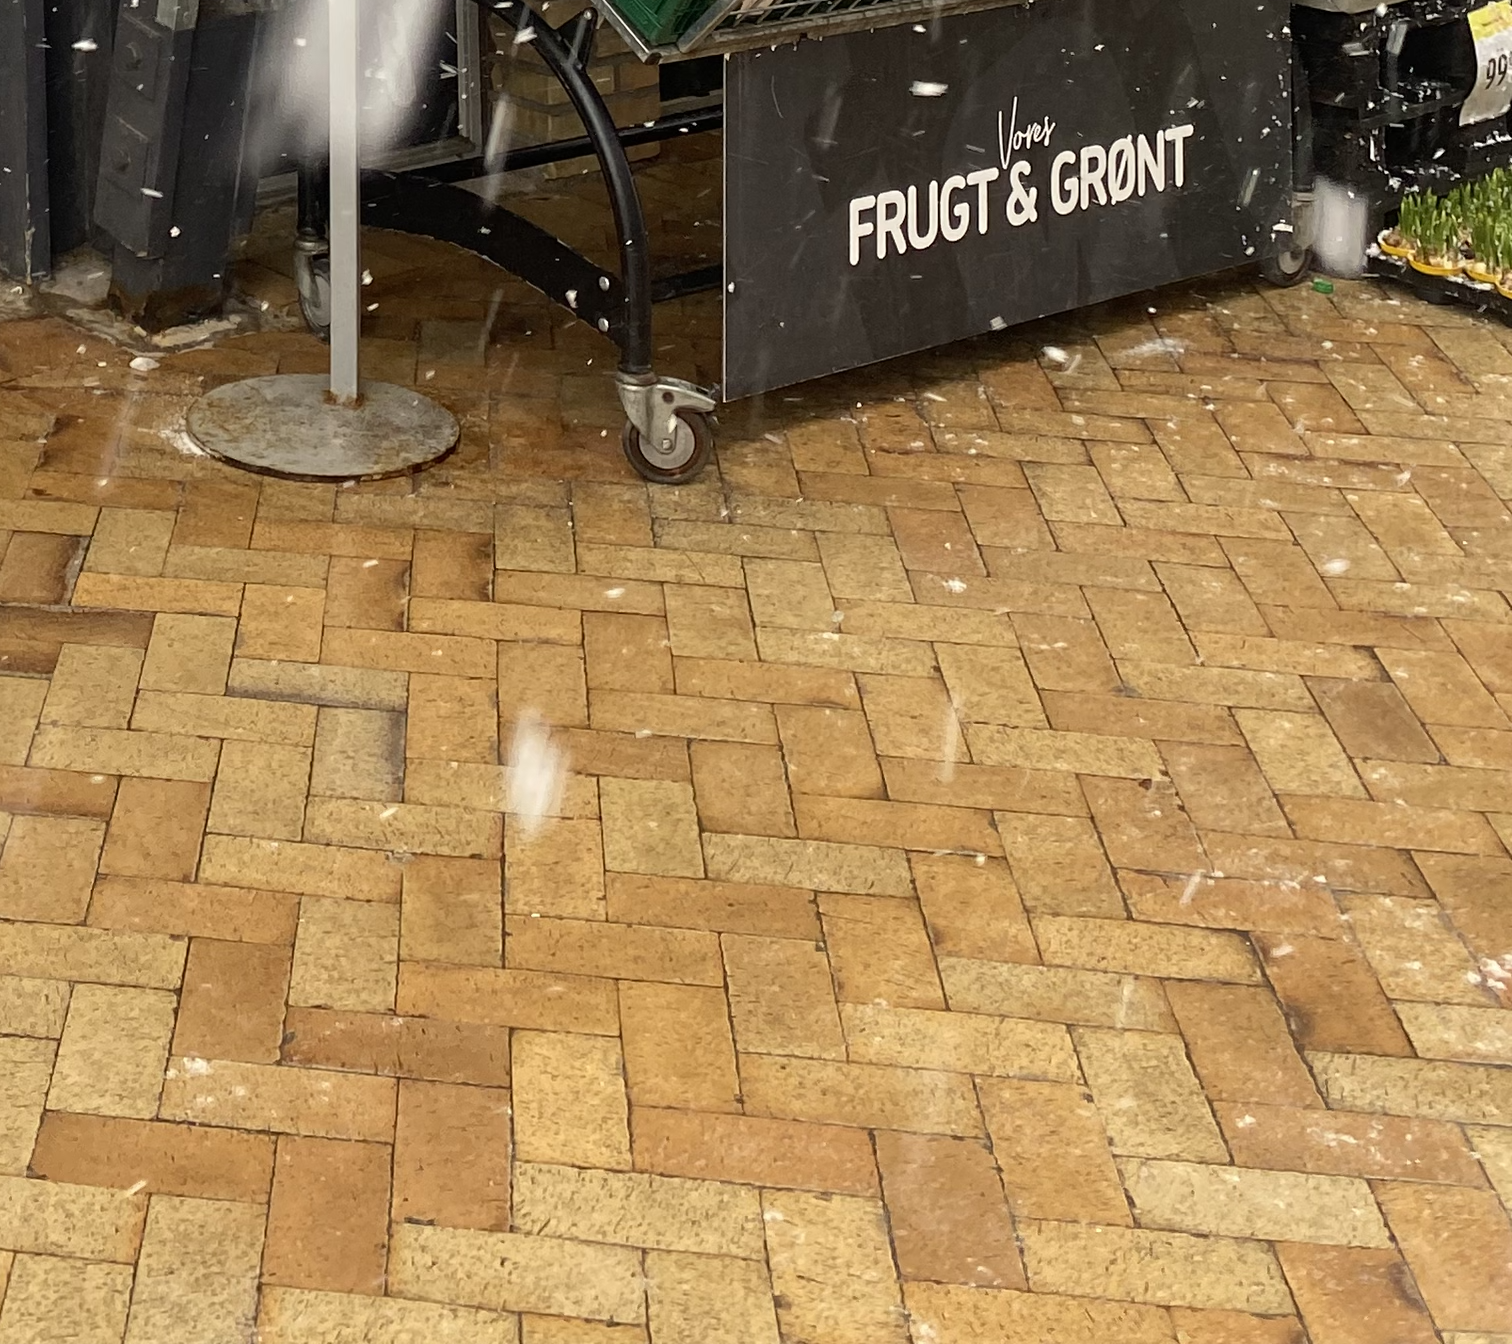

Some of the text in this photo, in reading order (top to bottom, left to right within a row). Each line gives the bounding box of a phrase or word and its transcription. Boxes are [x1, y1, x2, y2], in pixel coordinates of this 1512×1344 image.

[998, 96, 1056, 170] Vores
[848, 123, 1194, 267] FRUGT & GRØNT
